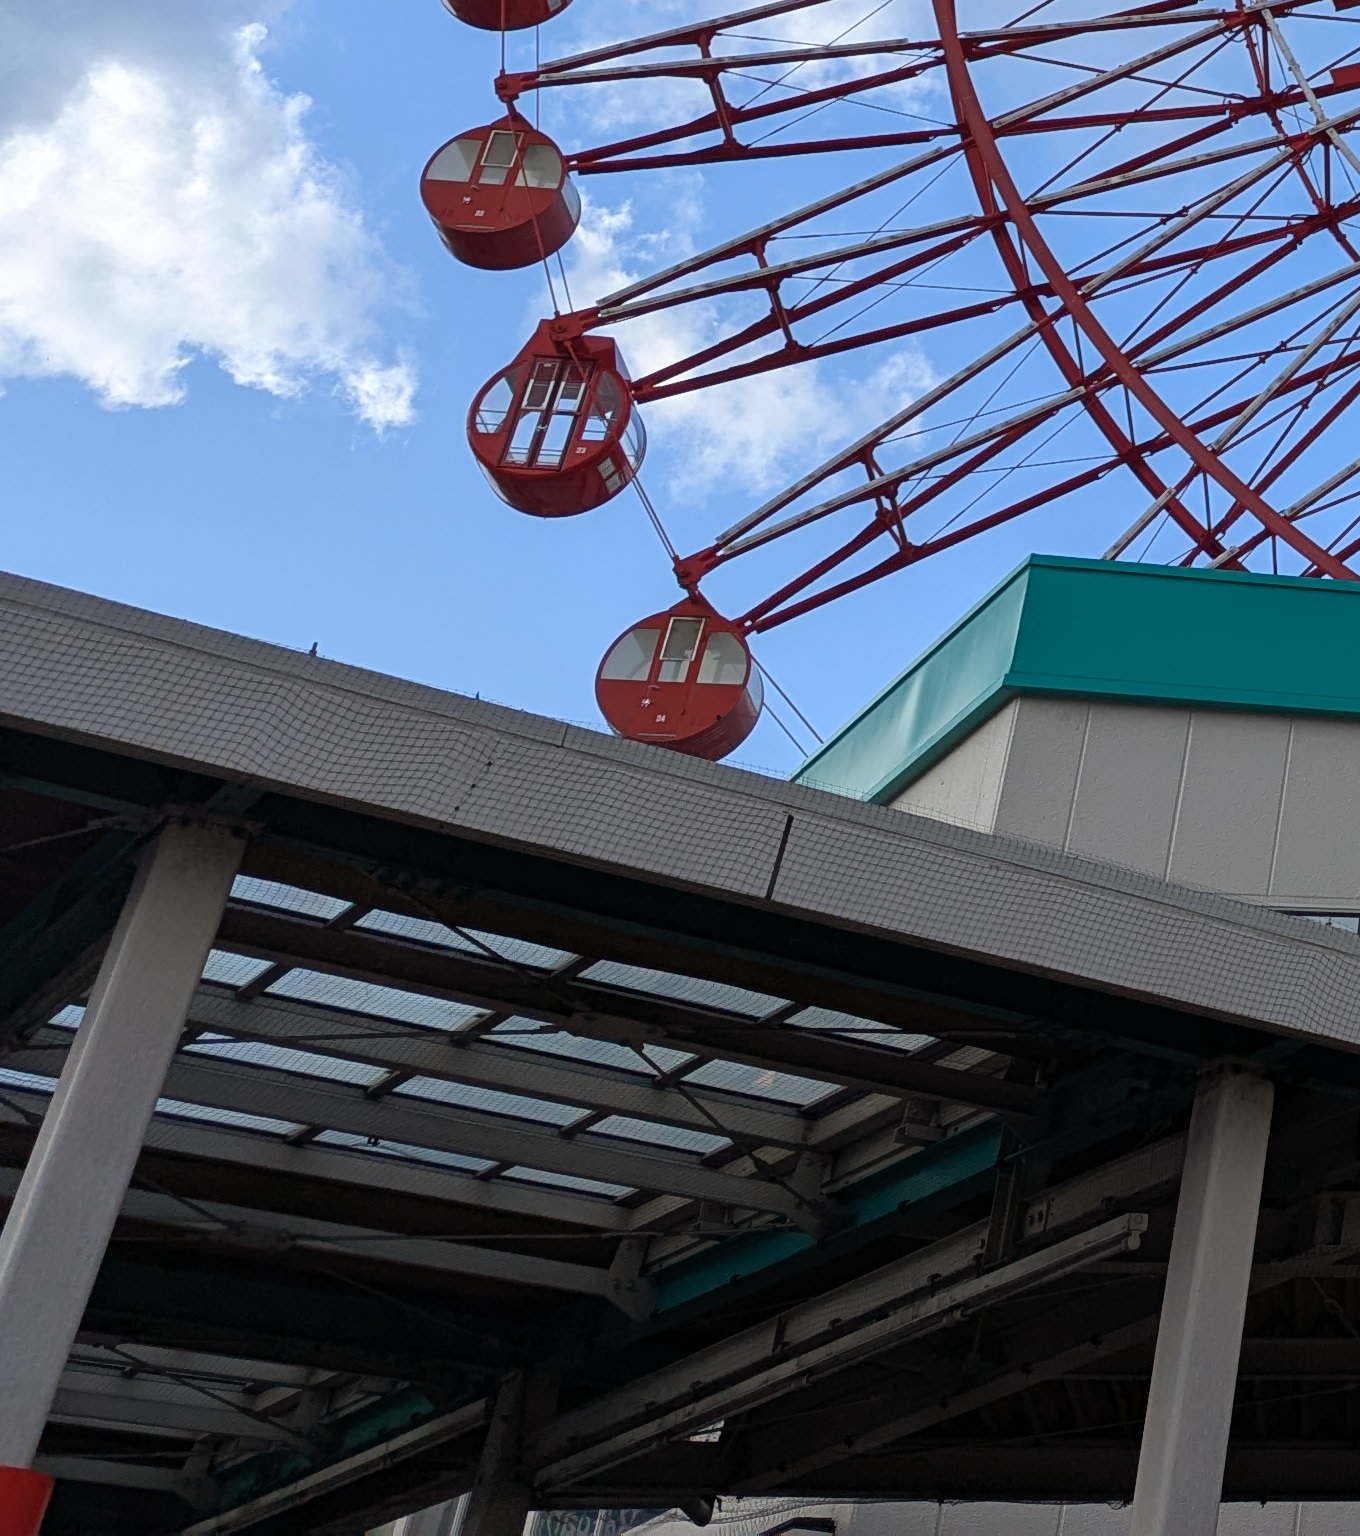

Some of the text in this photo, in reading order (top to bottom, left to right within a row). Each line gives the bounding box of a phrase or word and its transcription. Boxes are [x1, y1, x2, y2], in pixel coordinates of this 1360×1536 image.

[474, 209, 485, 217] 22
[575, 446, 587, 454] 23
[655, 714, 666, 723] 24
